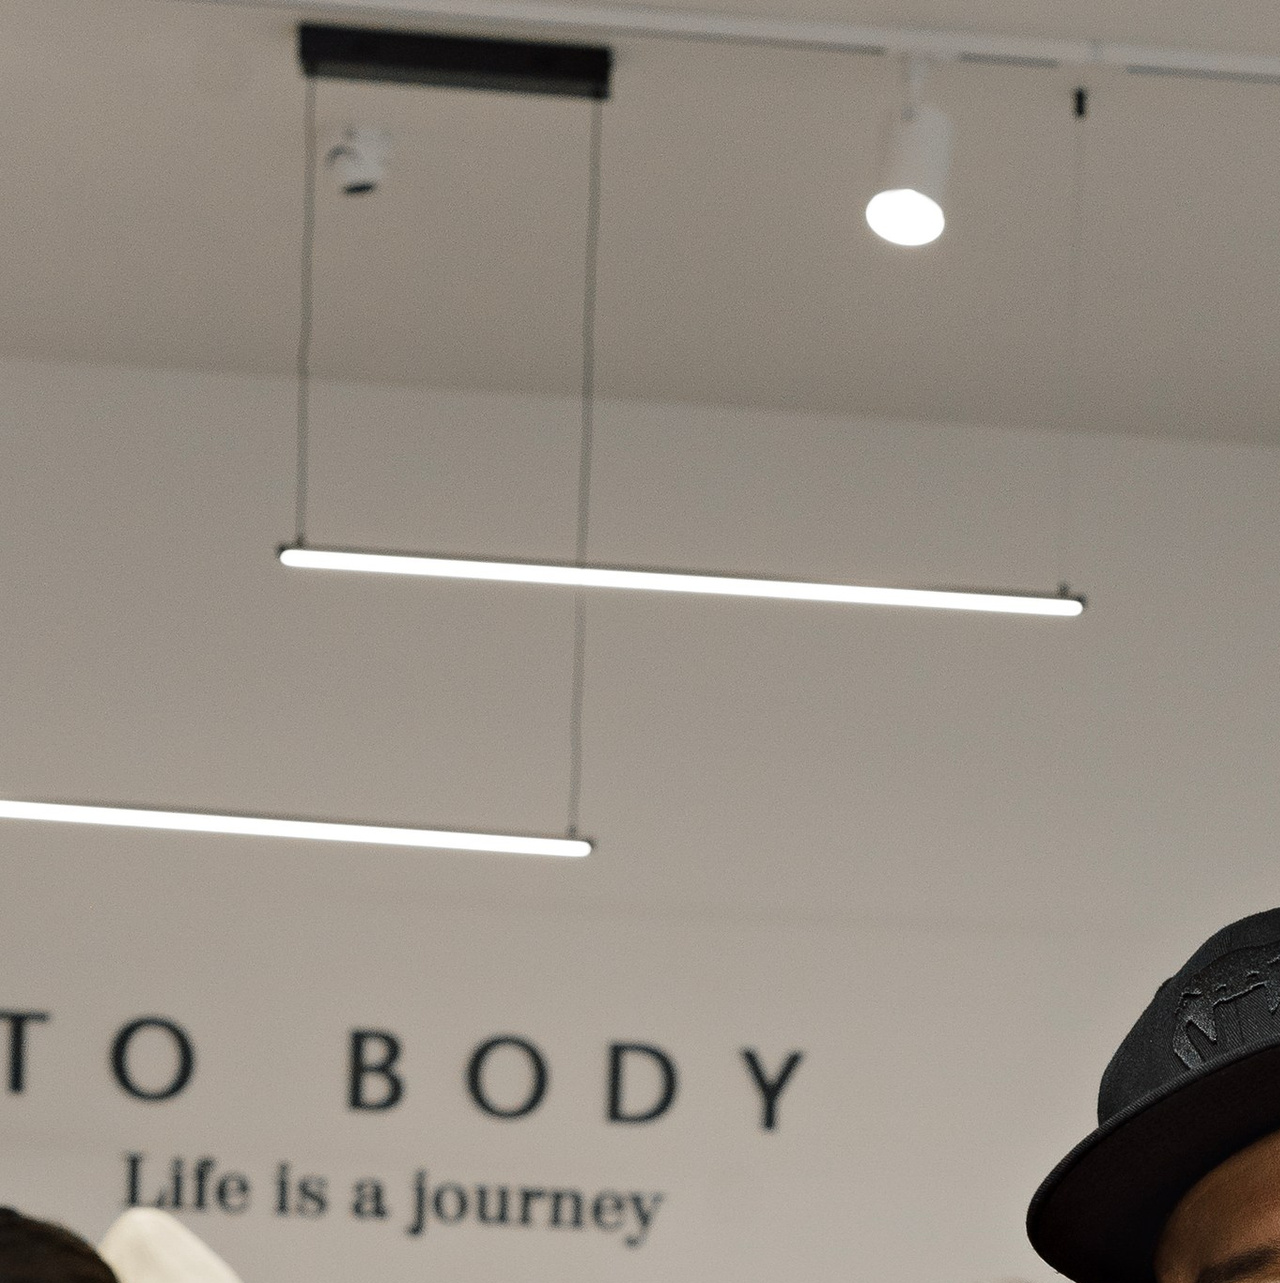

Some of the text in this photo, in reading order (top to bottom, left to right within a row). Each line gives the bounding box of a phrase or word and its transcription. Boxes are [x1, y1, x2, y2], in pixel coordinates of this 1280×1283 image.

[0, 1008, 805, 1132] TO BODY
[121, 1151, 665, 1247] Life is a journey
